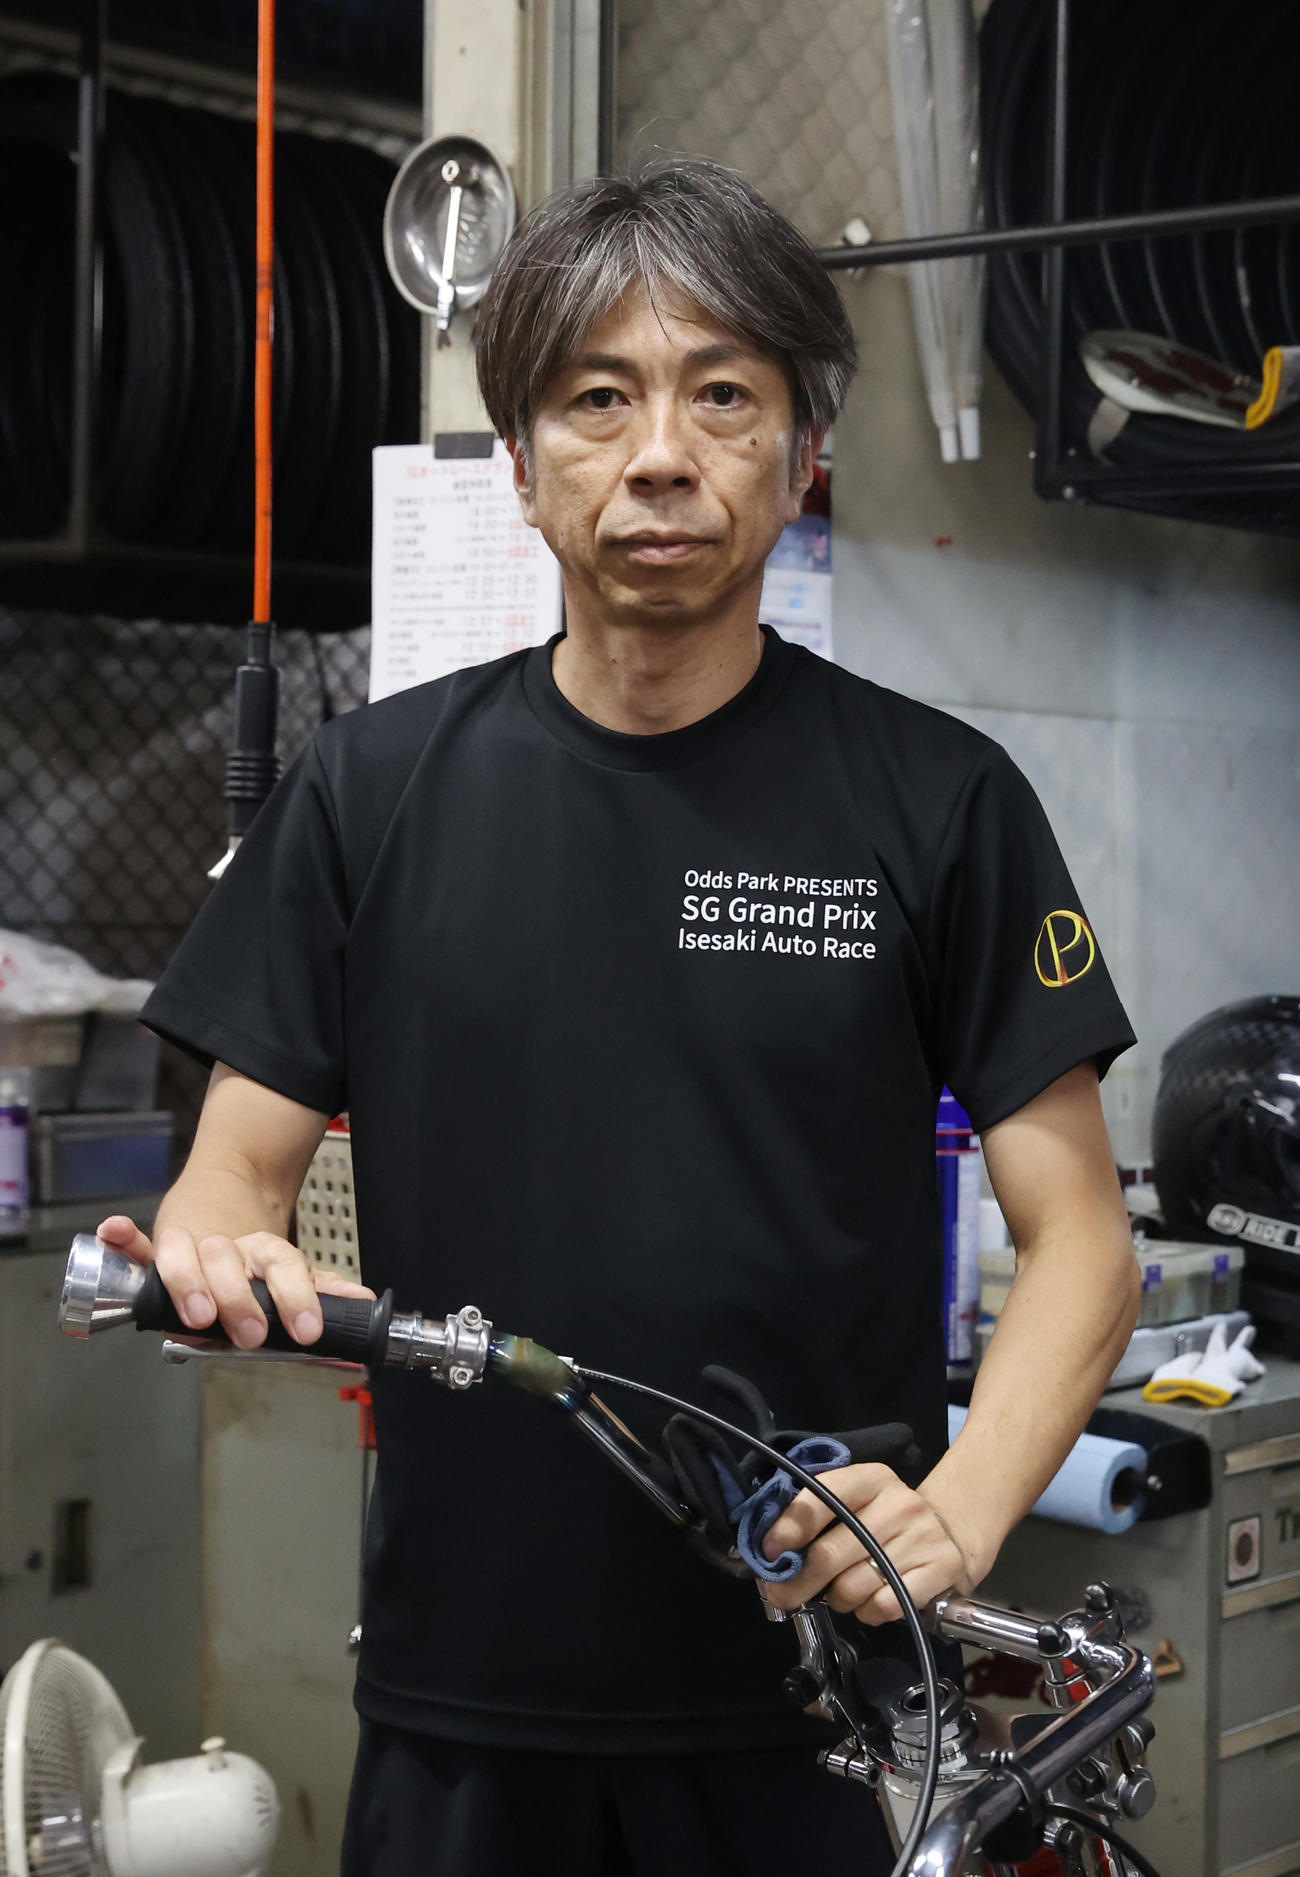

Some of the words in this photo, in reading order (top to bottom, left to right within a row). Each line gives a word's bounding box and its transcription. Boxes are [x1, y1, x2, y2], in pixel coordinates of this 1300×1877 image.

[684, 869, 733, 890] Odds
[737, 872, 779, 892] Park
[783, 875, 878, 897] PRESENTS
[681, 894, 721, 922] SG
[728, 896, 815, 928] Grand
[823, 902, 877, 931] Prix
[678, 927, 757, 952] Isesaki
[760, 931, 817, 956] Auto
[822, 936, 877, 960] Race
